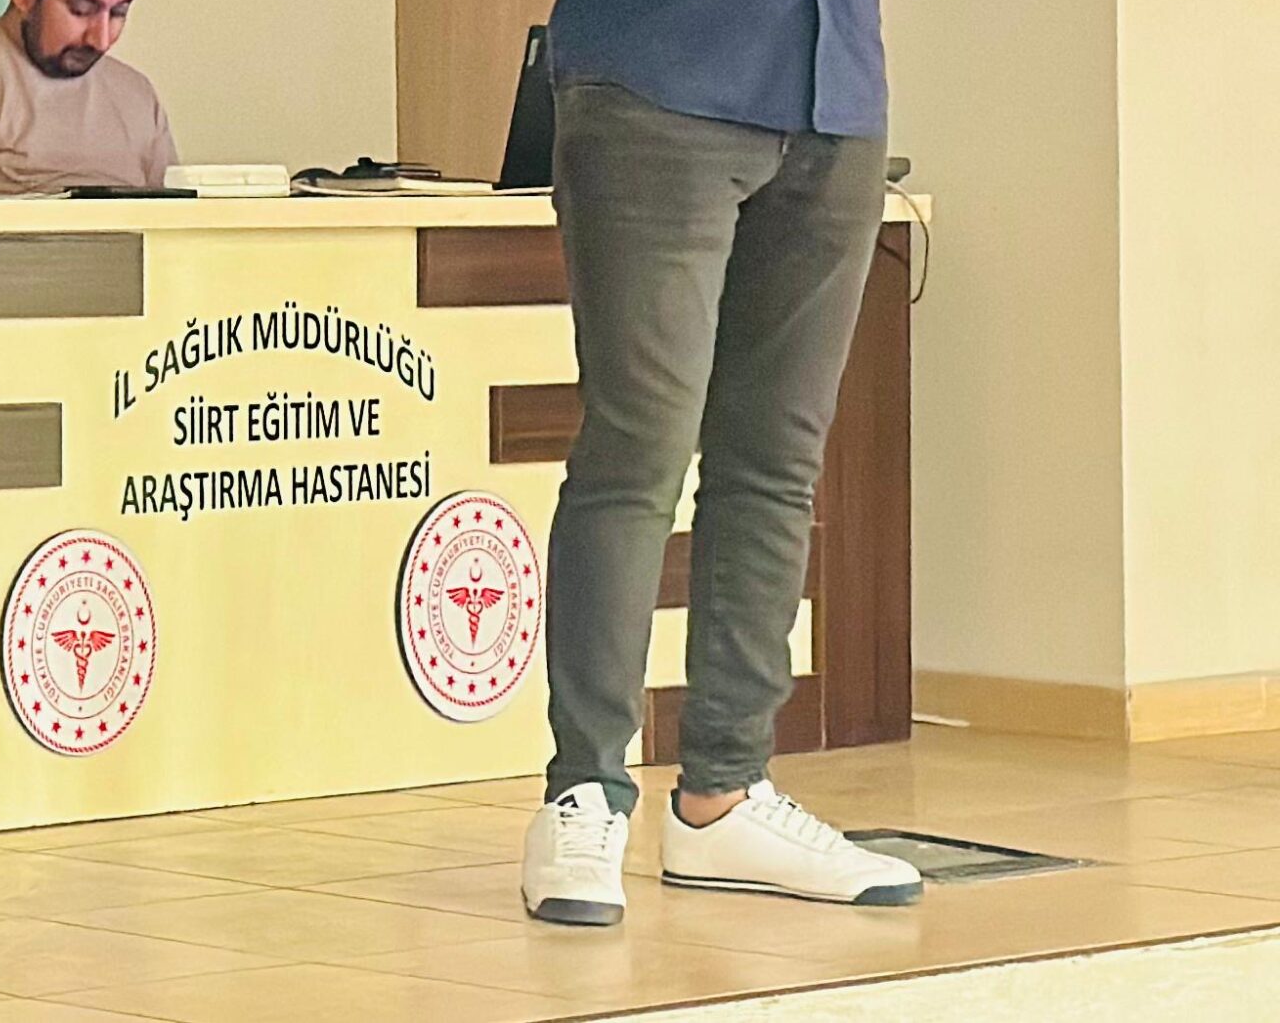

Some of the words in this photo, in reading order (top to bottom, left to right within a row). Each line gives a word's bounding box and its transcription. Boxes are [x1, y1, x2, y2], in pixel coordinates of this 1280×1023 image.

[114, 371, 136, 418] İL
[145, 318, 243, 392] SAĞLIK
[253, 301, 435, 402] MÜDÜRLÜĞÜ
[174, 395, 240, 446] SİİRT
[247, 391, 340, 442] EĞİTİM
[348, 398, 380, 437] VE
[121, 468, 283, 522] ARAŞTIRMA
[292, 450, 430, 506] HASTANESİ
